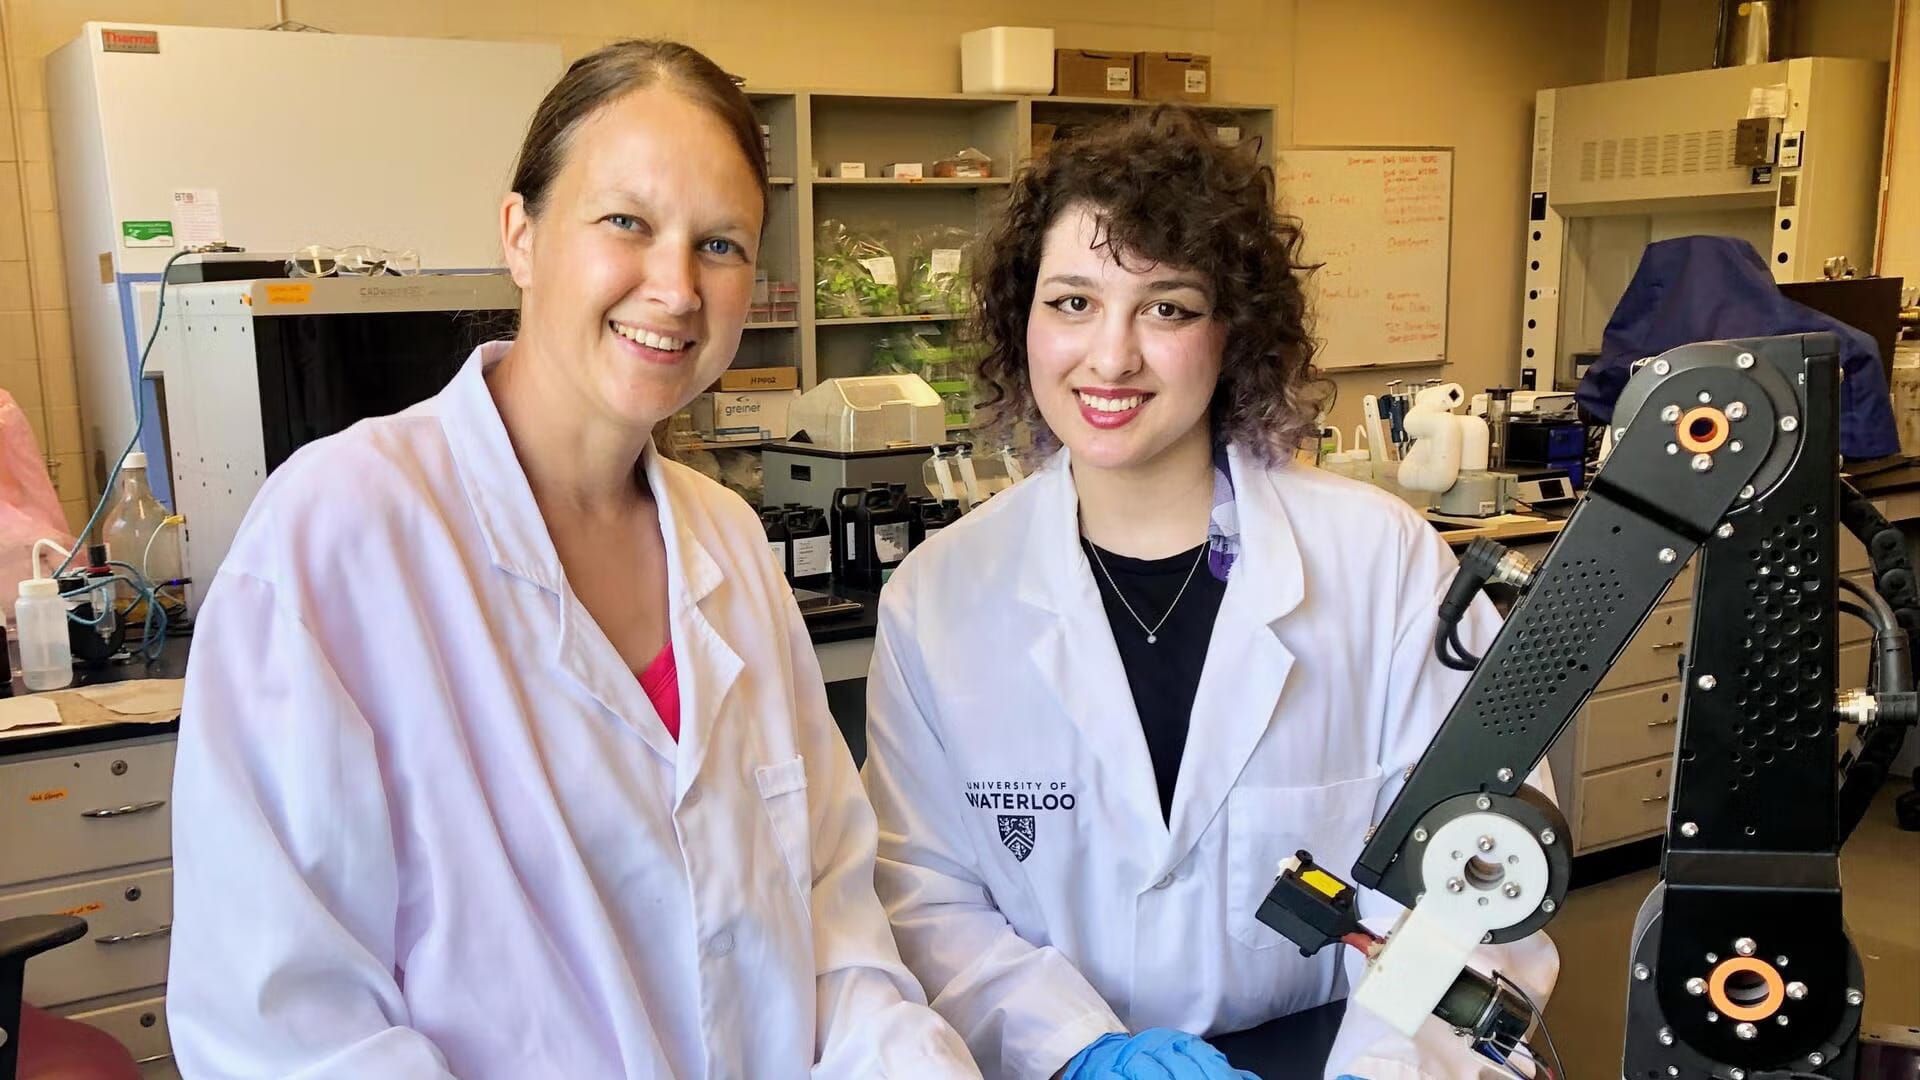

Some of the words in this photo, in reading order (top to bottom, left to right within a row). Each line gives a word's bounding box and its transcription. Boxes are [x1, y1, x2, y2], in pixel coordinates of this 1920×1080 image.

[103, 31, 157, 44] Thermo
[725, 404, 760, 416] greiner
[966, 781, 1042, 790] UNIVERSITY
[1050, 782, 1067, 790] OF
[965, 792, 1075, 810] WATERLOO
